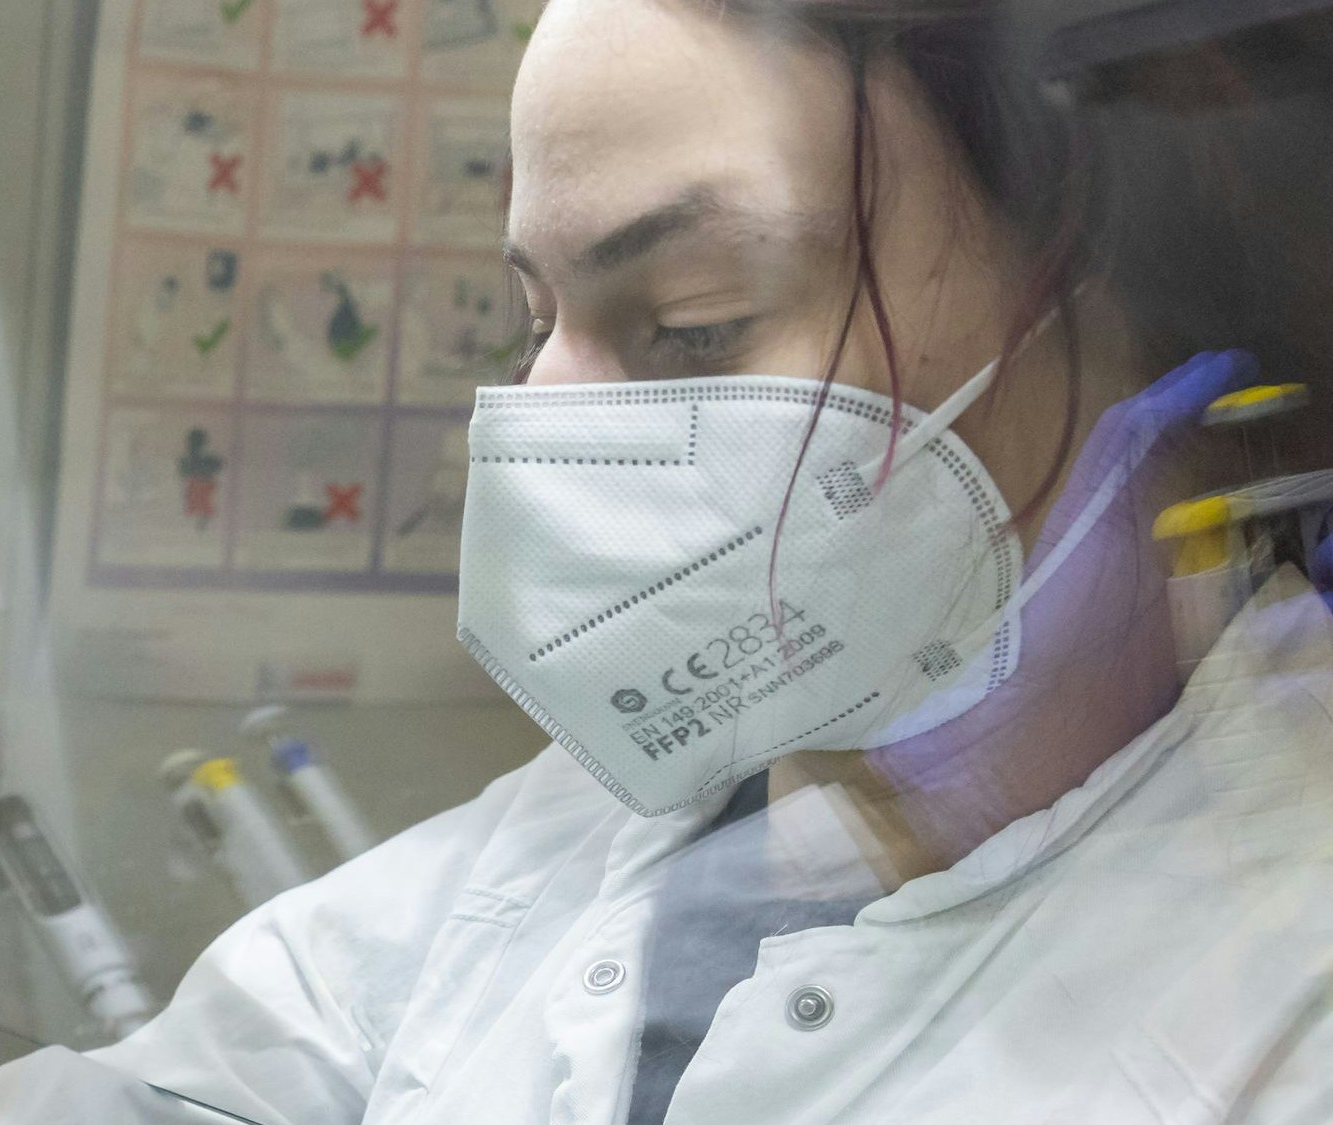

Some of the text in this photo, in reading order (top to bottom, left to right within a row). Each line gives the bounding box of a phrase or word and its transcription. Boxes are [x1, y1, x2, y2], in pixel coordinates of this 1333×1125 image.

[630, 724, 659, 746] EN
[642, 718, 711, 761] FFP2
[709, 695, 752, 725] NR
